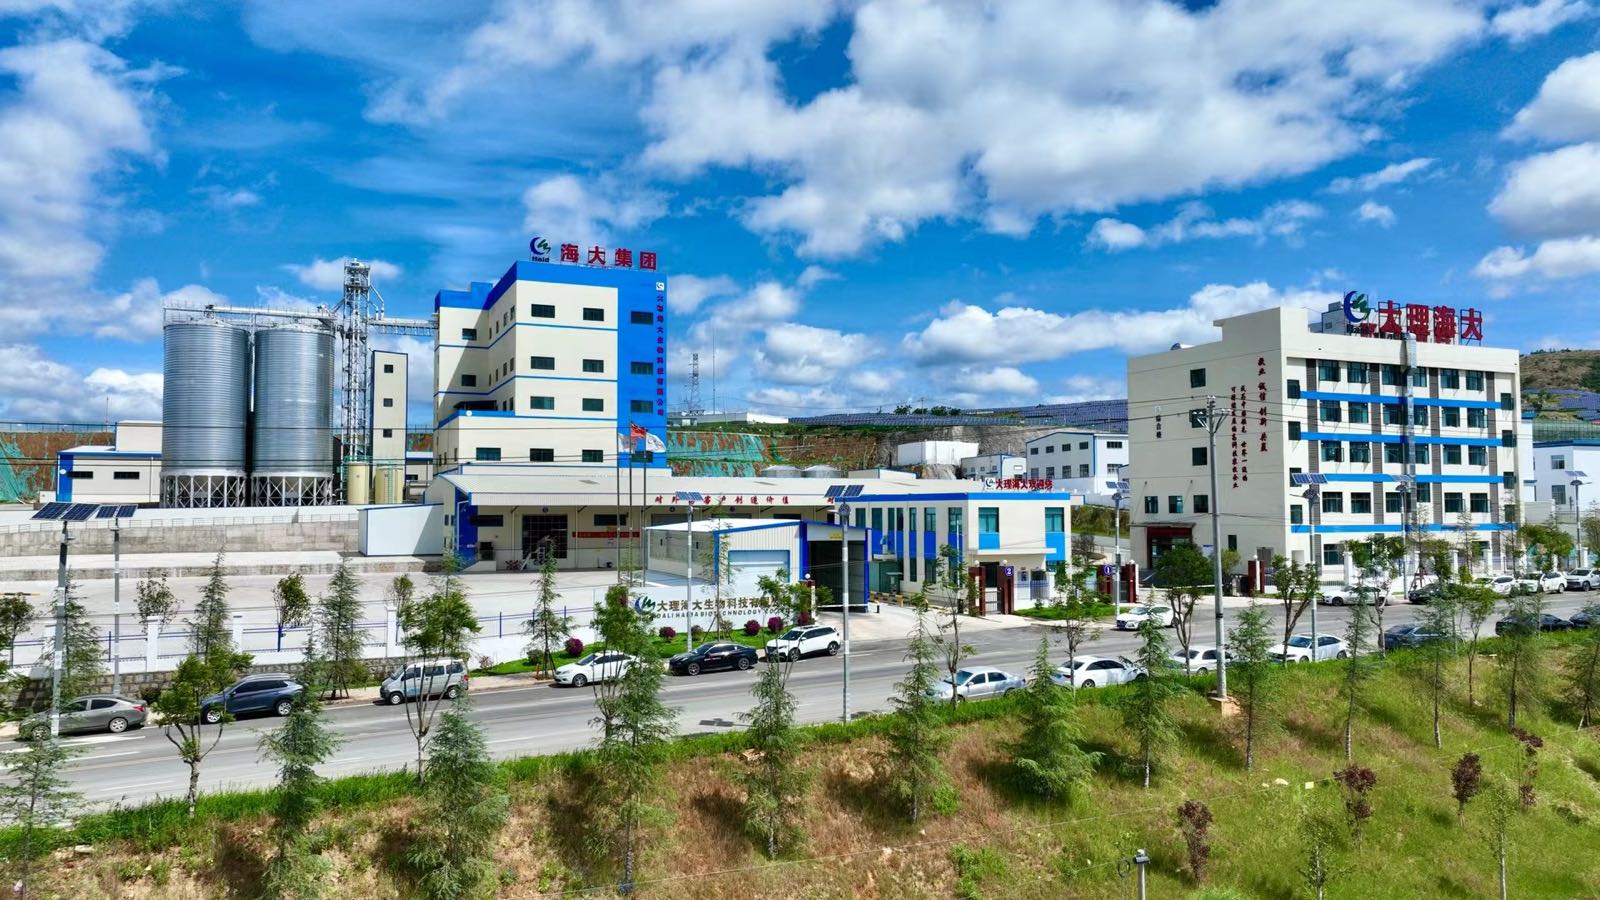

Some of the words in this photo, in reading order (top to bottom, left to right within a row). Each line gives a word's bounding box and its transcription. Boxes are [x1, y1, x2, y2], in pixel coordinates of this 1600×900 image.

[560, 243, 657, 270] 海大集团
[1379, 299, 1483, 340] 大理海大
